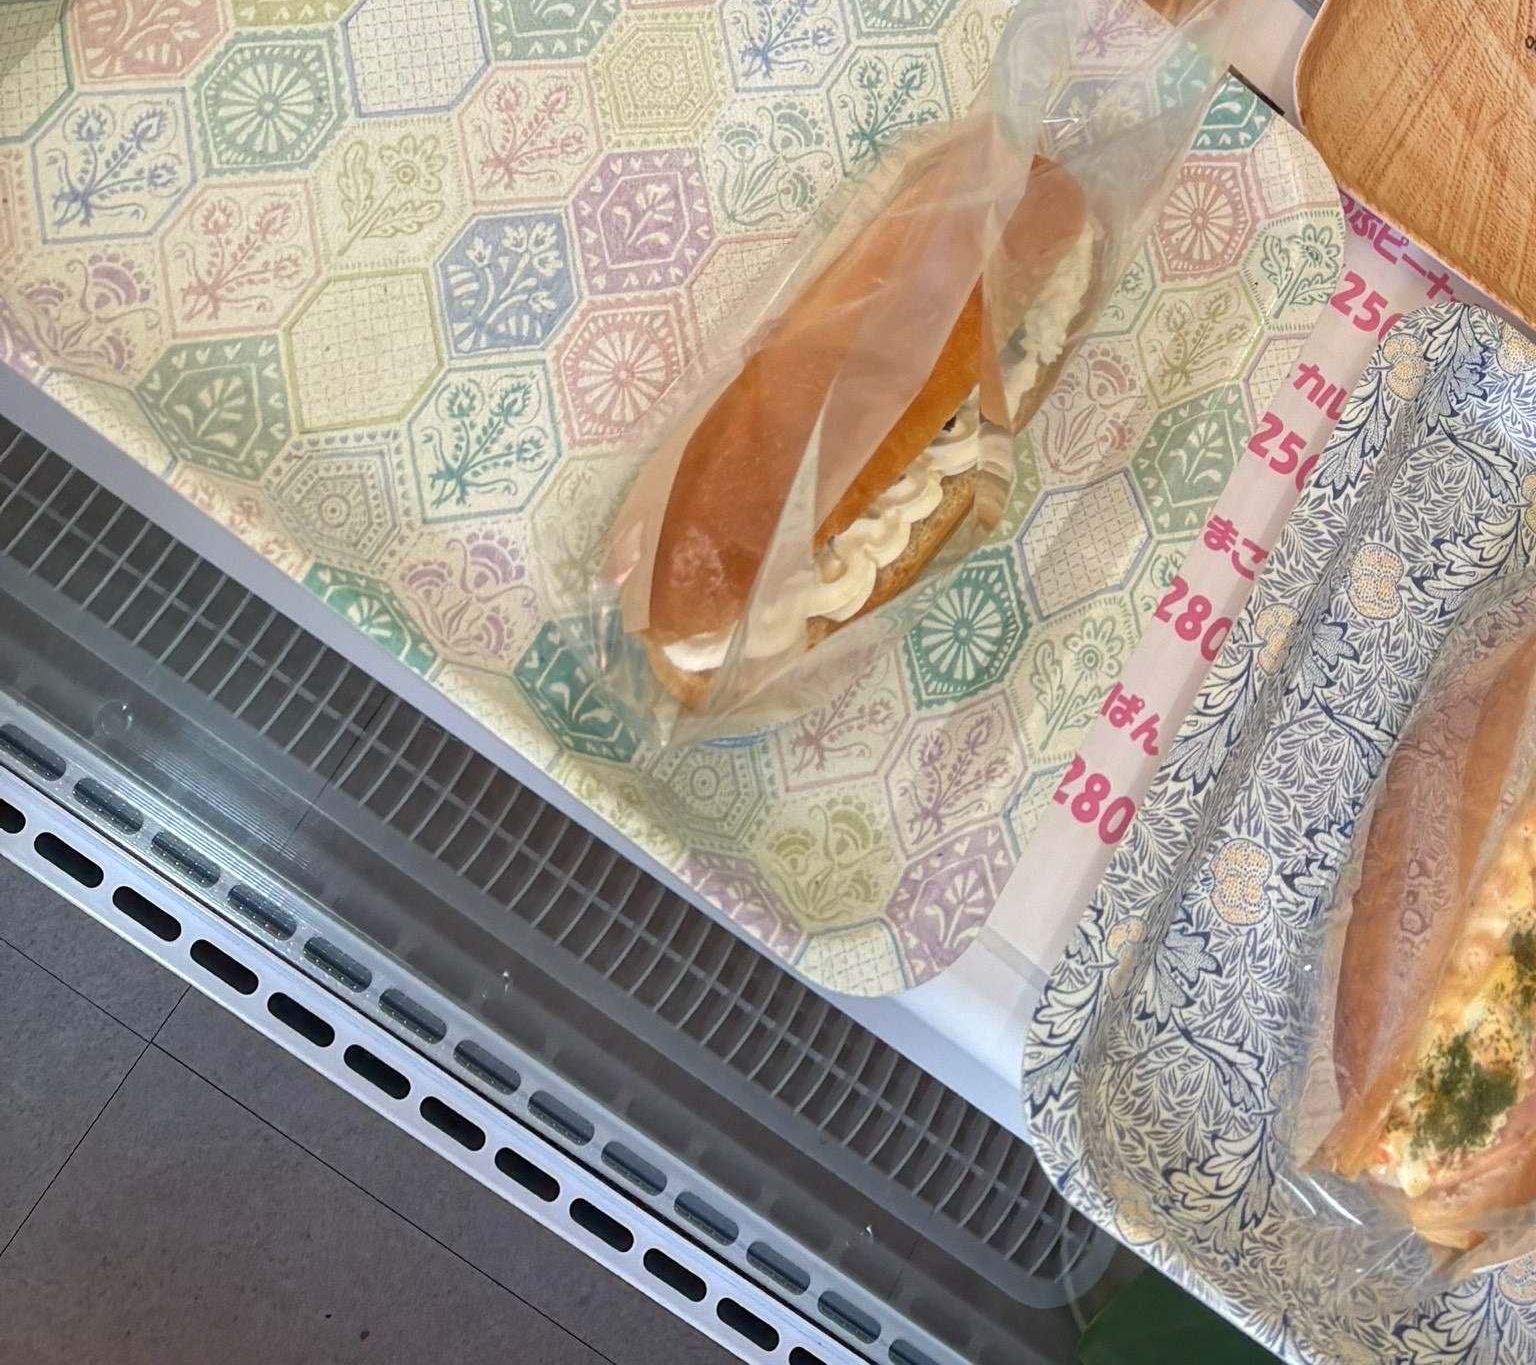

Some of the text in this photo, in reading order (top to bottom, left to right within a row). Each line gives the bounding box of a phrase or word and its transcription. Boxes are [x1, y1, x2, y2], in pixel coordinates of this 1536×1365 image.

[1153, 575, 1233, 662] 280
[1100, 681, 1160, 756] ぱん
[1052, 754, 1136, 844] 280
